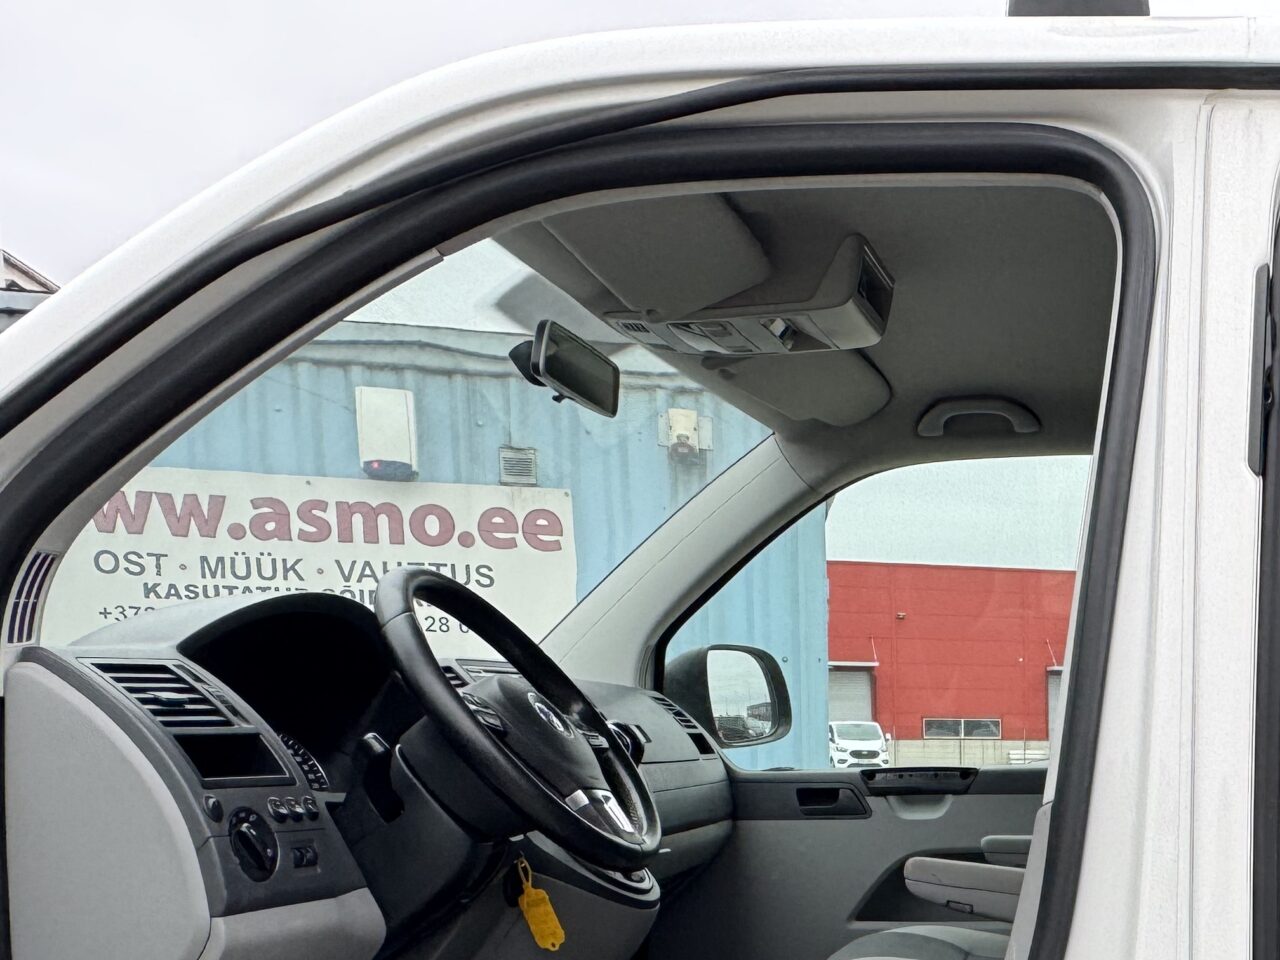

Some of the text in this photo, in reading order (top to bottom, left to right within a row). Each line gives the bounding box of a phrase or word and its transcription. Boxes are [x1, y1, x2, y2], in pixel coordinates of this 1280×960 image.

[93, 550, 495, 588] OST MÜÜK VAUS
[424, 615, 450, 633] 28
